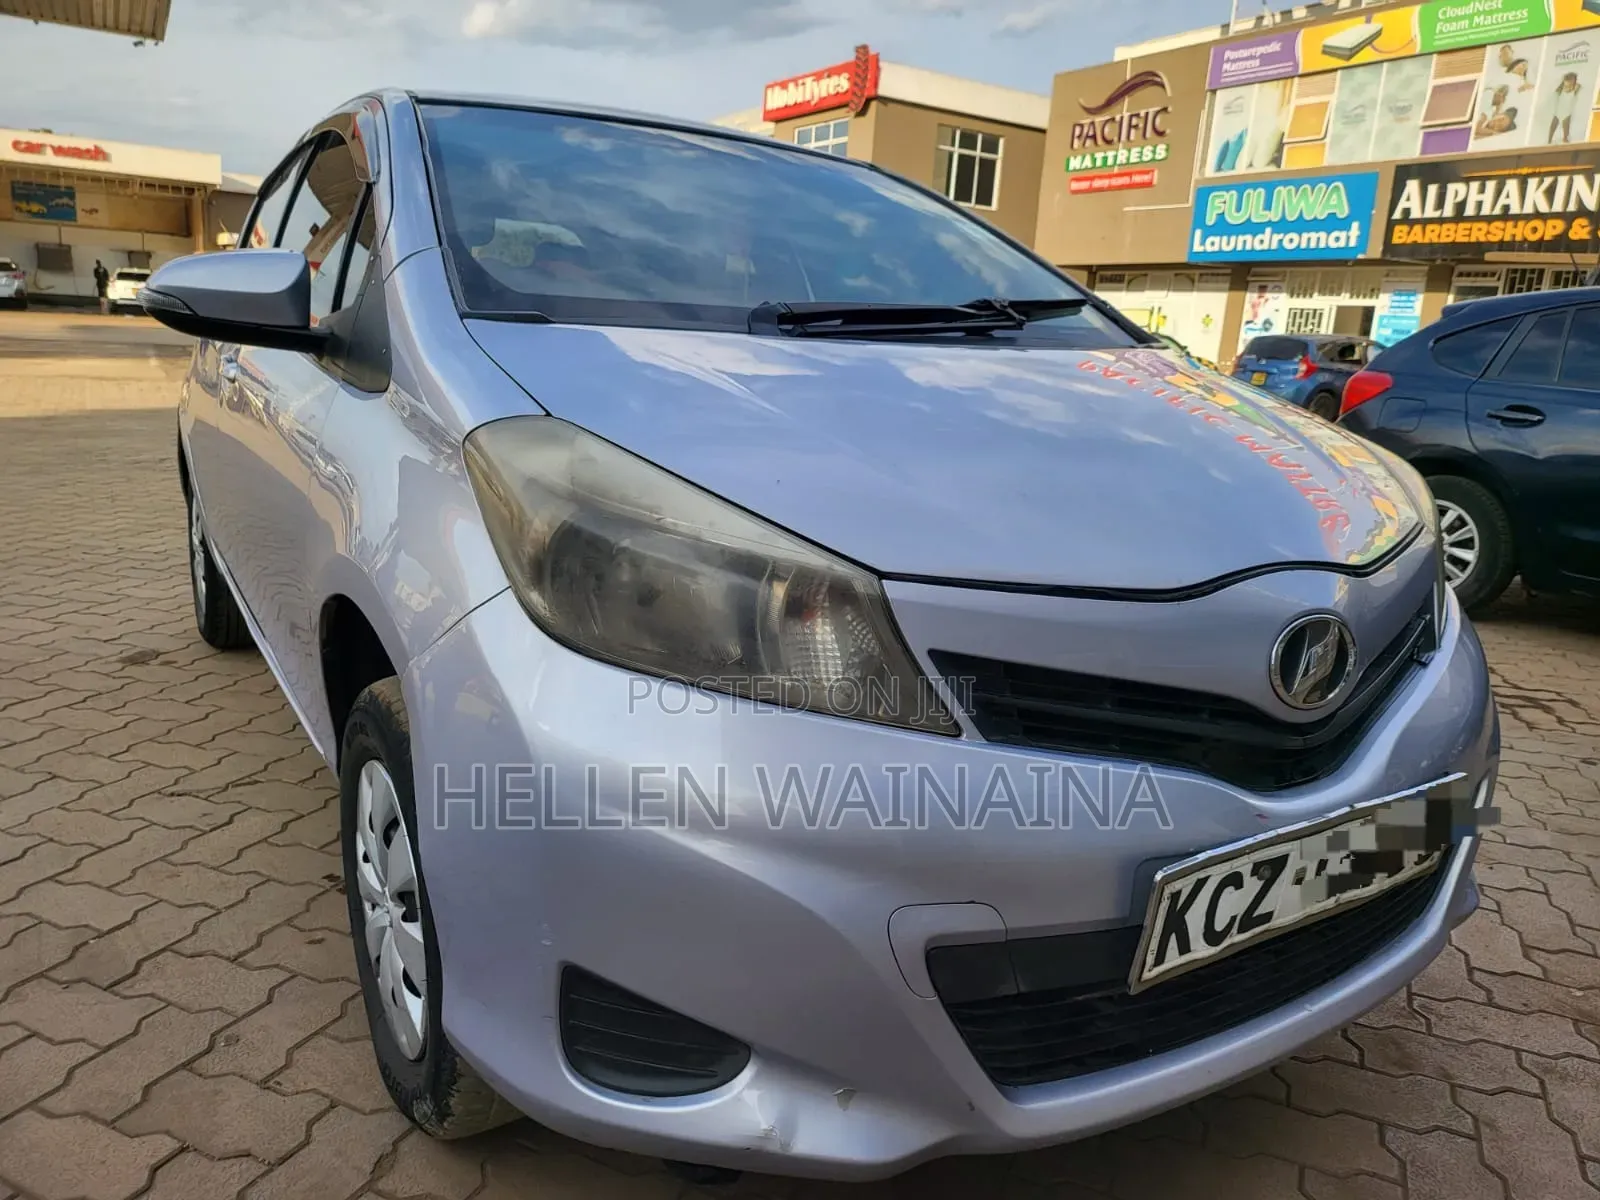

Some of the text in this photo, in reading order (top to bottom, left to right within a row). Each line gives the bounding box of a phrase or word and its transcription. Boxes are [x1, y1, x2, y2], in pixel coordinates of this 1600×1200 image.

[1435, 8, 1529, 34] Foam Mattress
[1438, 0, 1503, 20] CloudNest
[1069, 105, 1172, 150] PACIFIC
[11, 139, 112, 162] car wash
[1067, 143, 1168, 171] MATTRESS
[1205, 181, 1350, 226] FULIWA
[1391, 173, 1600, 220] ALPHAKIN
[1192, 221, 1361, 253] Laundromat
[1391, 218, 1566, 245] BARBERSHOP
[1568, 217, 1593, 241] &
[1154, 853, 1290, 967] KCZ
